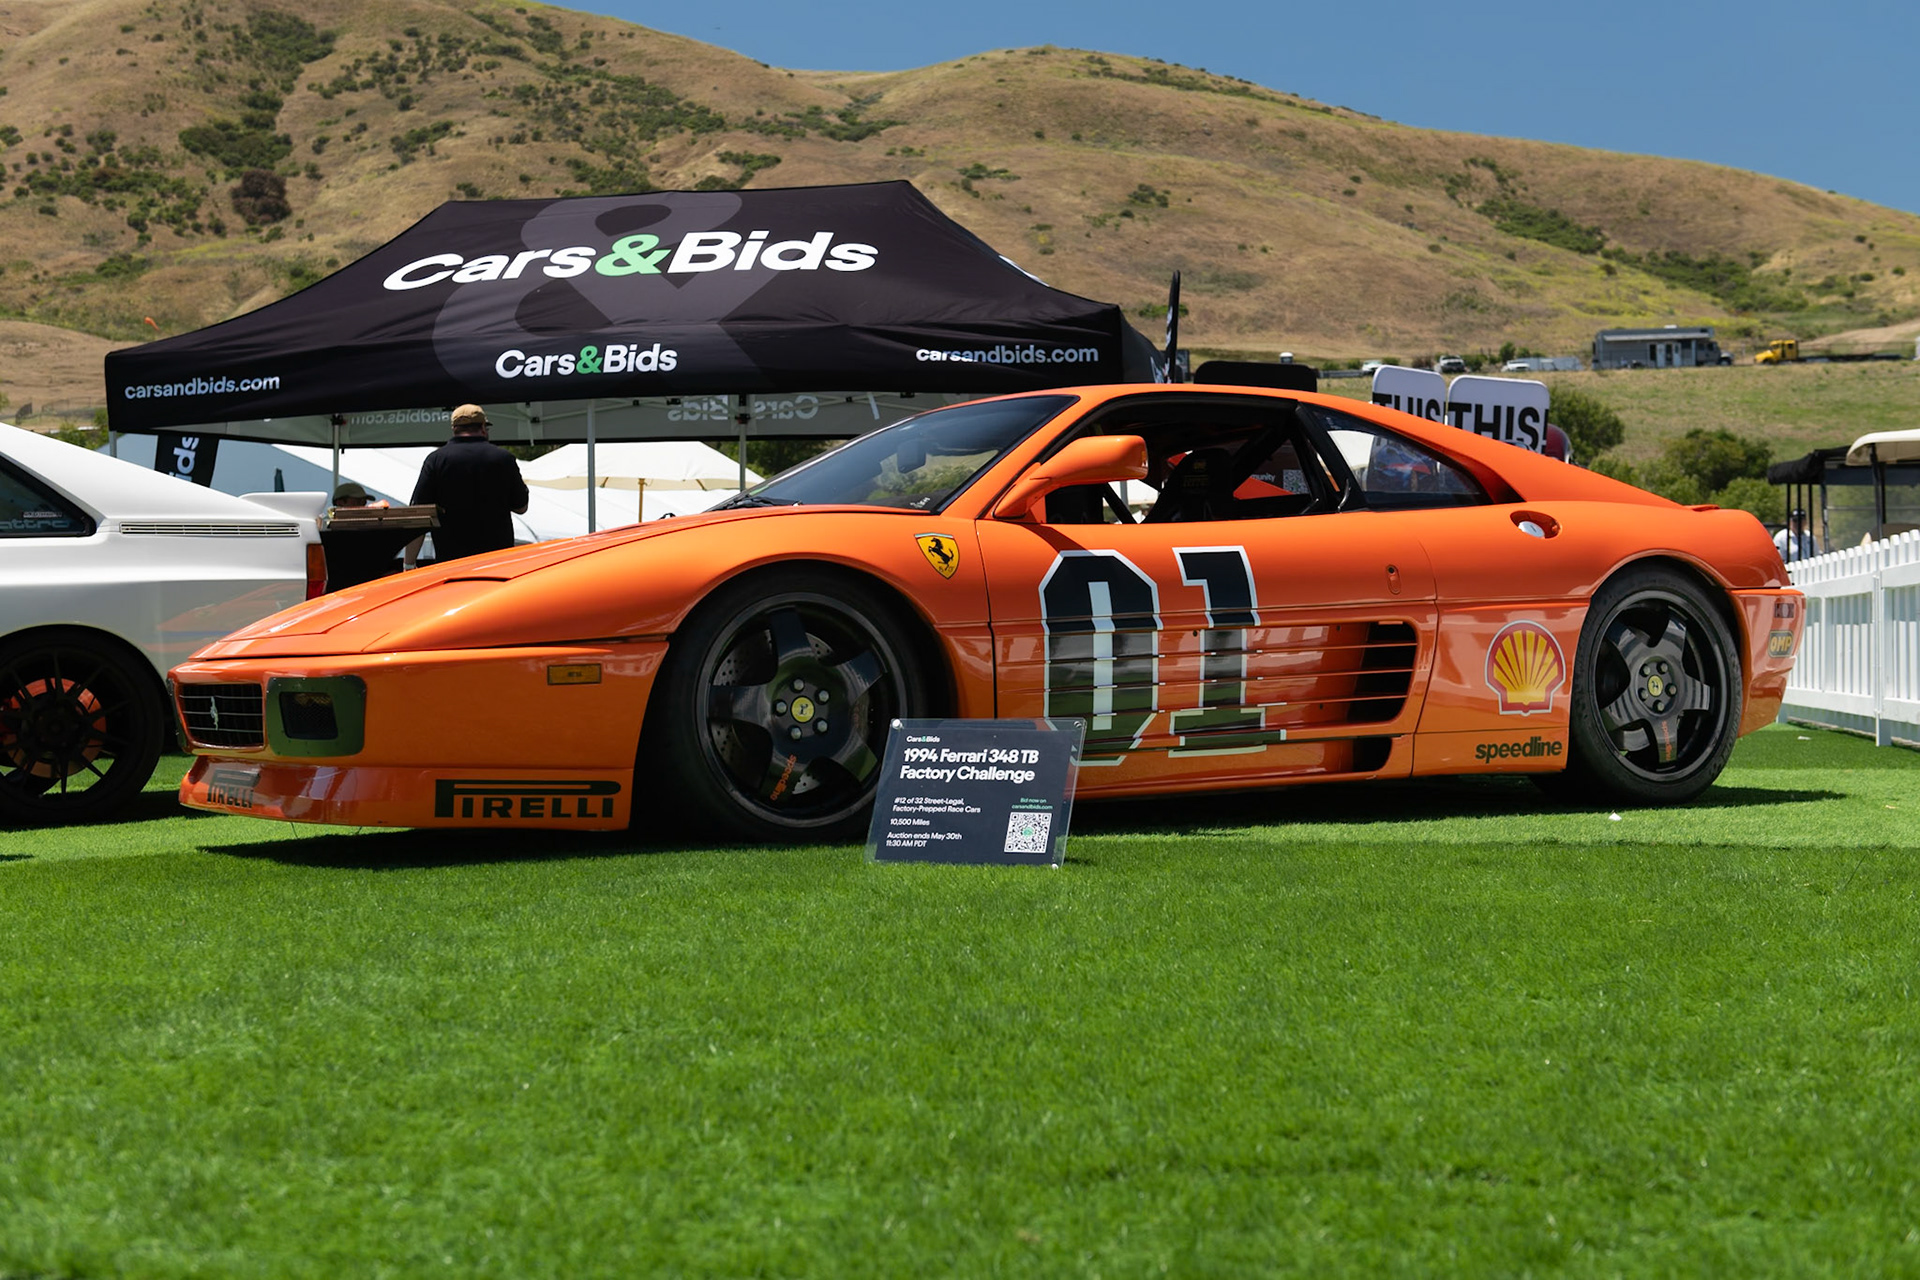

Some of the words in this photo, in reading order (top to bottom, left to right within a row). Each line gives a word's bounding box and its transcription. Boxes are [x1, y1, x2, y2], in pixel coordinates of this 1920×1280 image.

[382, 229, 879, 291] Cars&Bids
[495, 342, 678, 379] Cars&Bids
[915, 345, 1100, 365] carsandbids.com
[124, 374, 280, 400] carsandbids.com
[1770, 636, 1793, 652] OMP
[906, 735, 941, 743] Cars&Bids
[903, 748, 939, 762] 1994
[939, 748, 989, 763] Ferrari
[988, 748, 1019, 764] 348
[1020, 749, 1040, 764] TB
[1475, 735, 1563, 763] speedline
[899, 765, 957, 783] Factory
[956, 765, 1036, 784] Challenge
[207, 768, 262, 808] PIRELLI
[434, 778, 622, 819] PIRELLI
[892, 805, 947, 813] Factory-Prepped
[964, 805, 981, 813] Cars
[912, 818, 930, 826] Miles
[887, 832, 913, 840] Auction
[913, 832, 931, 840] ends
[930, 832, 946, 841] May
[945, 832, 963, 840] 30th
